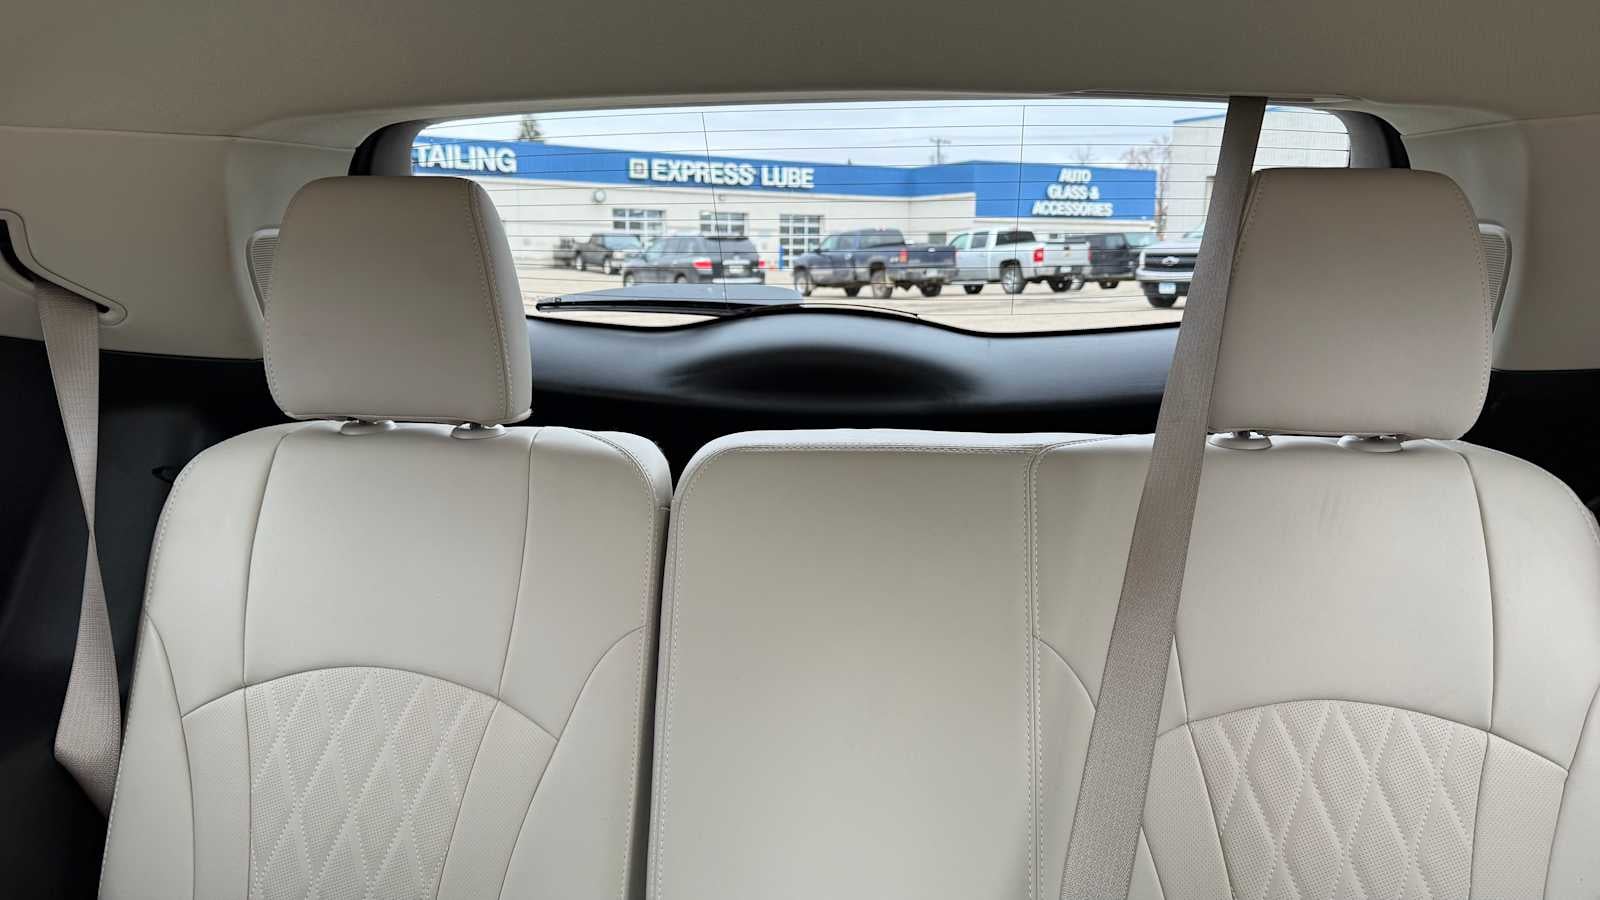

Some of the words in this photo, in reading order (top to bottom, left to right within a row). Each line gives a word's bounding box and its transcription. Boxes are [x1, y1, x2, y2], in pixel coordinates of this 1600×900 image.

[412, 143, 517, 173] TAILING
[652, 158, 755, 186] EXPRESS
[761, 165, 815, 189] LUBE
[1059, 168, 1092, 184] AUTO
[1047, 184, 1088, 200] GLASS
[1088, 186, 1099, 200] &
[1032, 201, 1113, 217] ACCESSORIES
